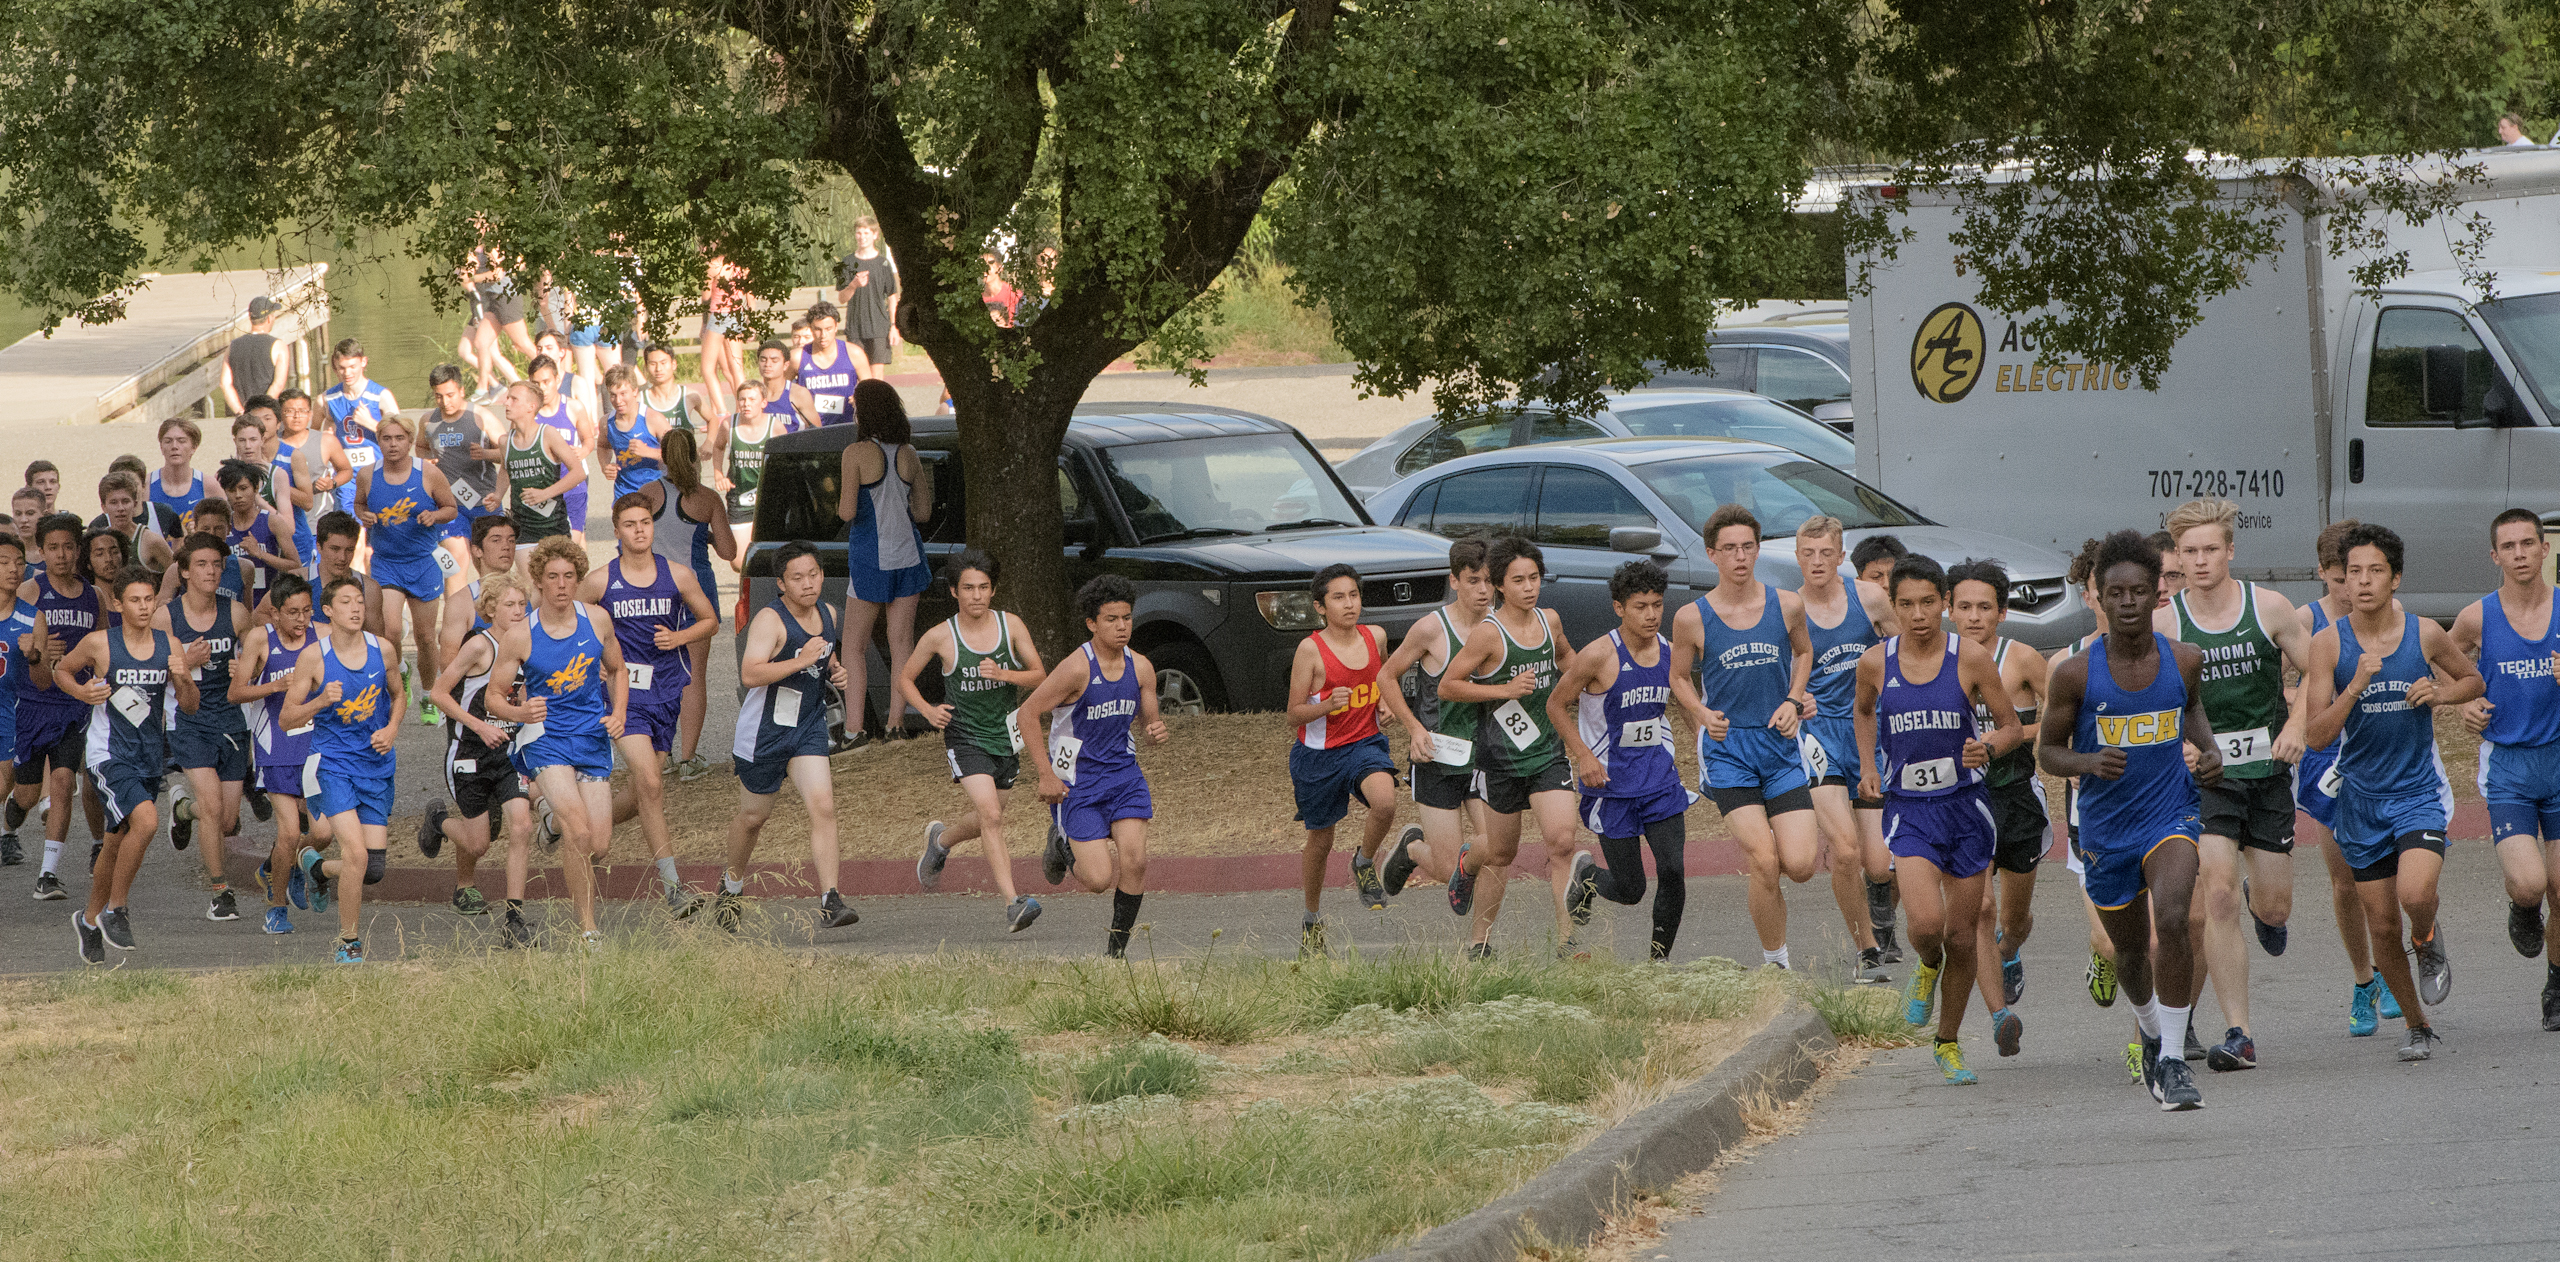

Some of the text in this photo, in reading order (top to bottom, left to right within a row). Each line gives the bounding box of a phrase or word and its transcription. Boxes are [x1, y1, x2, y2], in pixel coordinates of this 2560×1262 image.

[805, 373, 849, 389] ROSELAND
[1995, 363, 2129, 392] ELECTRIC
[822, 399, 836, 410] 24
[438, 433, 463, 447] RCP
[351, 452, 366, 463] 95
[509, 457, 542, 469] SONOMA
[734, 450, 763, 460] SONOM
[510, 467, 546, 479] ACADEMY
[2148, 469, 2284, 497] 707-228-7410
[457, 486, 473, 502] 33
[2237, 511, 2272, 529] Service
[613, 598, 672, 618] ROSELAND
[45, 609, 94, 629] ROSELAND
[1718, 642, 1779, 665] TECH HIGH
[1818, 643, 1867, 665] TECH HIGH
[2201, 641, 2256, 664] ONOMA
[1723, 657, 1778, 670] TRACK
[1823, 658, 1859, 675] CROSS COUNT
[2201, 658, 2262, 682] CADEMY
[2497, 657, 2555, 674] TECH HI
[116, 669, 167, 685] CREDO
[2515, 669, 2555, 680] TITAN
[960, 679, 1007, 692] ACADEM
[2388, 680, 2412, 693] HIG
[126, 699, 139, 711] 7
[1620, 686, 1671, 709] ROSELAN
[1087, 699, 1137, 720] ROSELAND
[2361, 702, 2382, 713] CROSS
[1505, 712, 1529, 736] 83
[1888, 710, 1961, 735] ROSELAND
[2097, 710, 2178, 745] VCA
[1634, 725, 1653, 742] 15
[2229, 736, 2254, 758] 37
[1056, 745, 1073, 771] 28
[1914, 766, 1942, 787] 31
